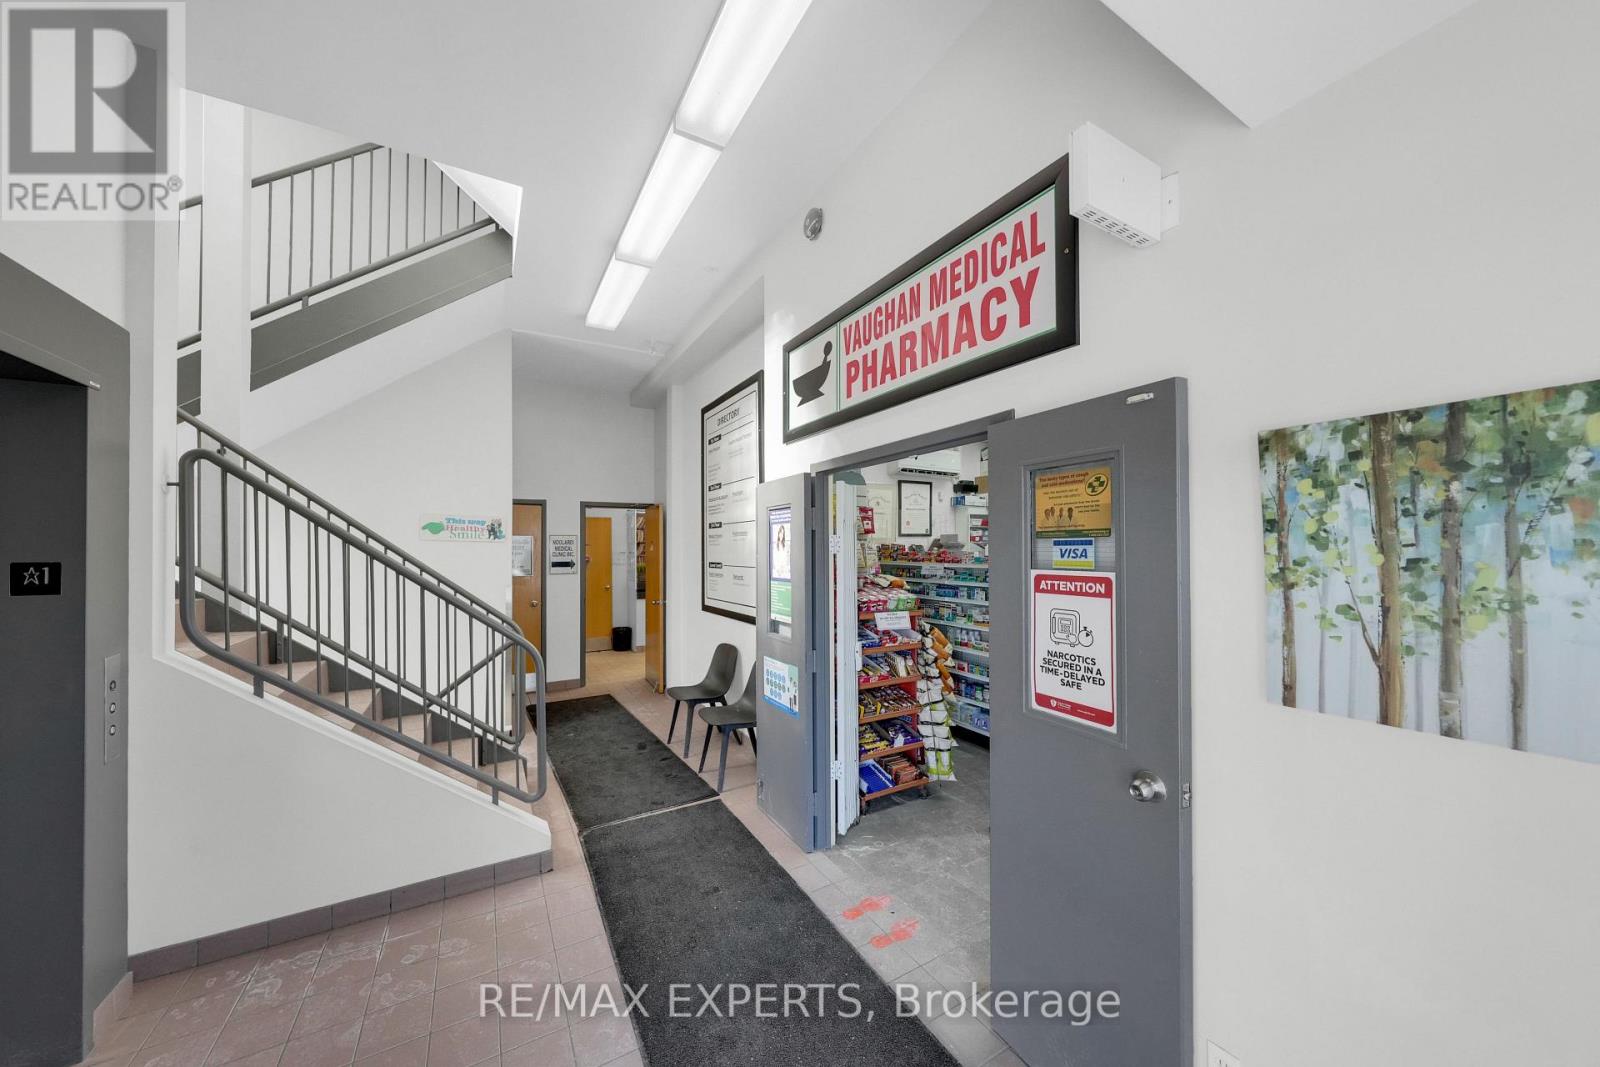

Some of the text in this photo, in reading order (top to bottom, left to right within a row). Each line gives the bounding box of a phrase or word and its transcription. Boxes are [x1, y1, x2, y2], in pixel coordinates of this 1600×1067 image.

[843, 211, 1046, 356] VAUGHAN MEDICAL
[846, 266, 1041, 399] PHARMACY
[717, 407, 740, 427] DIRECTORY
[444, 517, 487, 527] This way
[446, 524, 487, 535] Healthy
[1059, 548, 1088, 559] VISA
[42, 567, 49, 584] 1
[1039, 580, 1105, 594] ATTENTION
[1047, 650, 1096, 666] NARCOTICS
[1042, 657, 1102, 677] SECURED IN A
[1040, 665, 1105, 687] TIME-DELAYED
[1060, 678, 1082, 690] SAFE
